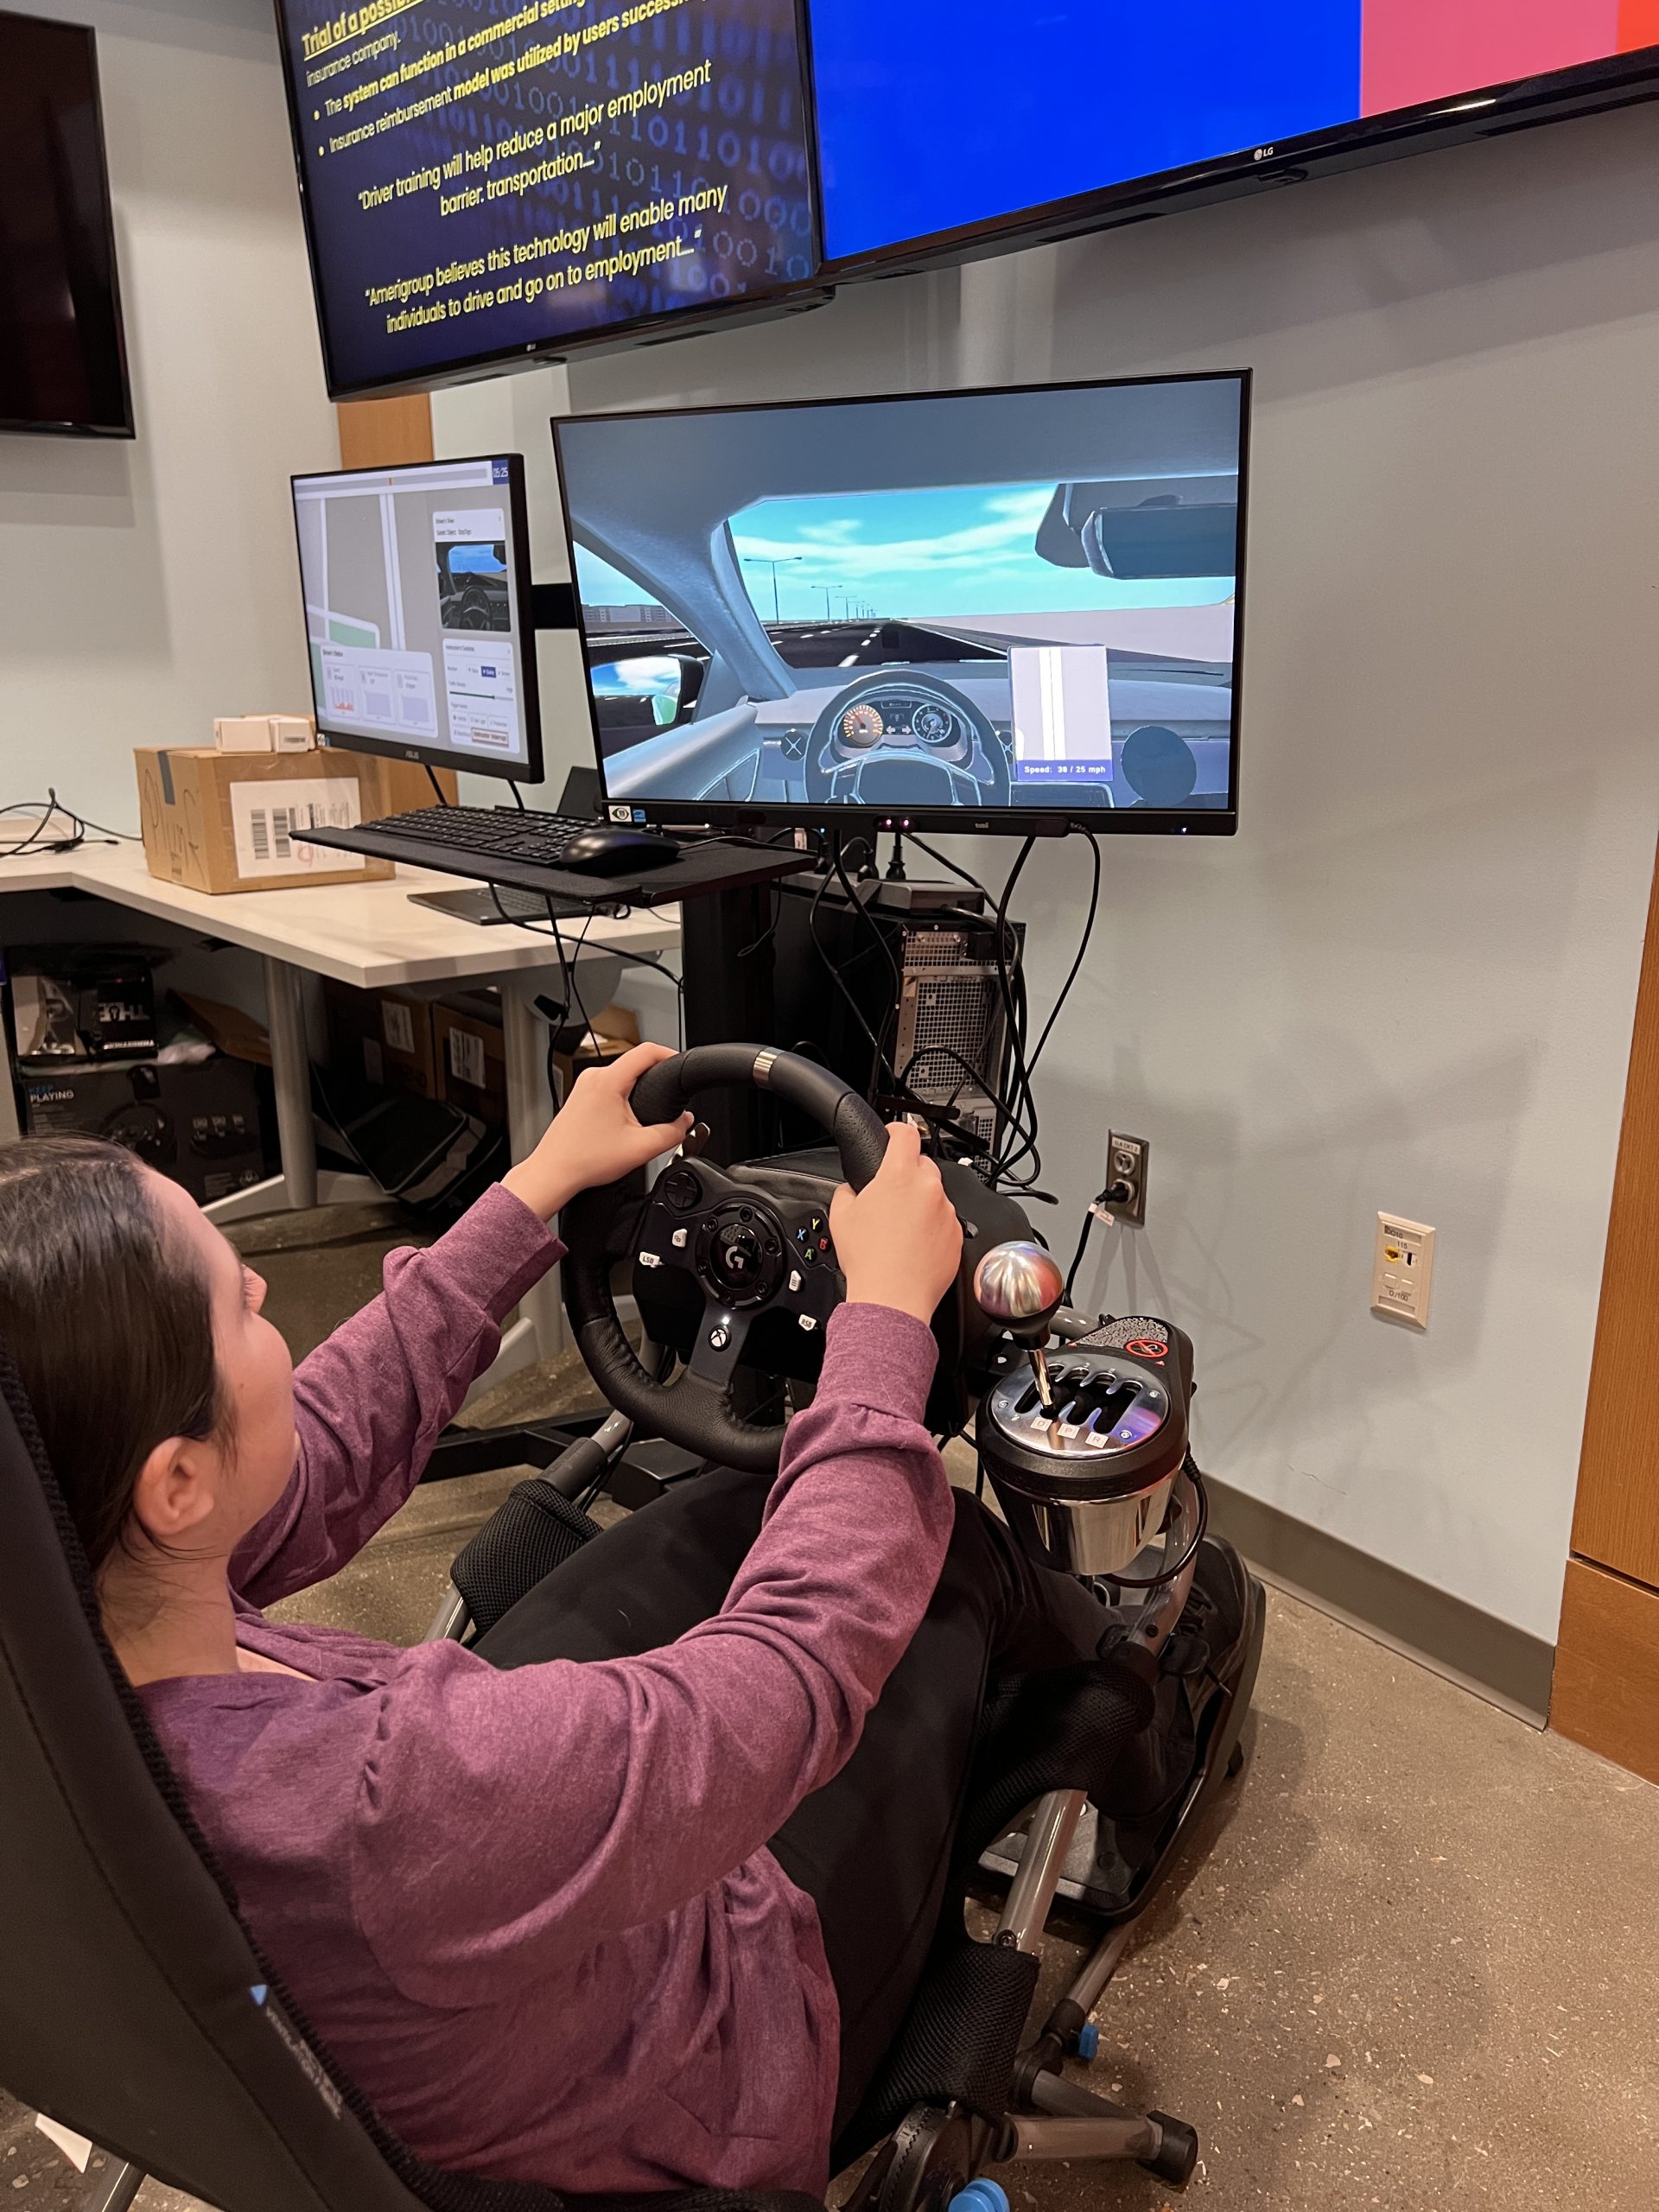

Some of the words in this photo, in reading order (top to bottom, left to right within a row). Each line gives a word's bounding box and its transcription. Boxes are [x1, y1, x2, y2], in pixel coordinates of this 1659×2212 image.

[302, 21, 333, 55] Trial
[333, 11, 346, 40] of
[347, 16, 359, 34] a
[360, 0, 410, 35] possib
[306, 54, 353, 87] insurance
[352, 31, 401, 65] company.
[325, 98, 342, 117] The
[342, 81, 379, 111] system
[379, 70, 399, 92] can
[399, 49, 444, 82] function
[445, 41, 457, 60] in
[457, 39, 467, 55] a
[467, 1, 538, 52] commercial
[329, 123, 375, 153] Insurance
[375, 86, 453, 133] reimbursement
[454, 67, 490, 100] model
[491, 62, 516, 85] was
[517, 35, 562, 73] utilized
[563, 32, 581, 55] by
[582, 16, 620, 45] users
[396, 167, 441, 197] training
[442, 153, 462, 180] will
[465, 144, 493, 172] help
[496, 128, 543, 160] reduce
[546, 123, 556, 141] a
[560, 103, 604, 137] major
[607, 59, 712, 117] employment
[1263, 147, 1274, 157] LG
[435, 258, 485, 288] believes
[487, 246, 511, 271] this
[512, 226, 590, 264] technology
[593, 213, 617, 242] will
[620, 198, 675, 233] enable
[678, 185, 728, 217] many
[386, 301, 447, 334] individuals
[448, 297, 461, 316] to
[463, 291, 493, 314] drive
[496, 278, 523, 305] and
[524, 277, 543, 303] go
[546, 271, 563, 291] on
[567, 265, 582, 283] to
[1024, 766, 1052, 774] Speed:
[1089, 766, 1106, 775] mph
[30, 1089, 75, 1103] PLAYING
[812, 1218, 821, 1230] Y
[797, 1229, 807, 1241] X
[819, 1238, 829, 1250] B
[804, 1249, 814, 1261] A
[801, 1319, 812, 1329] RSB
